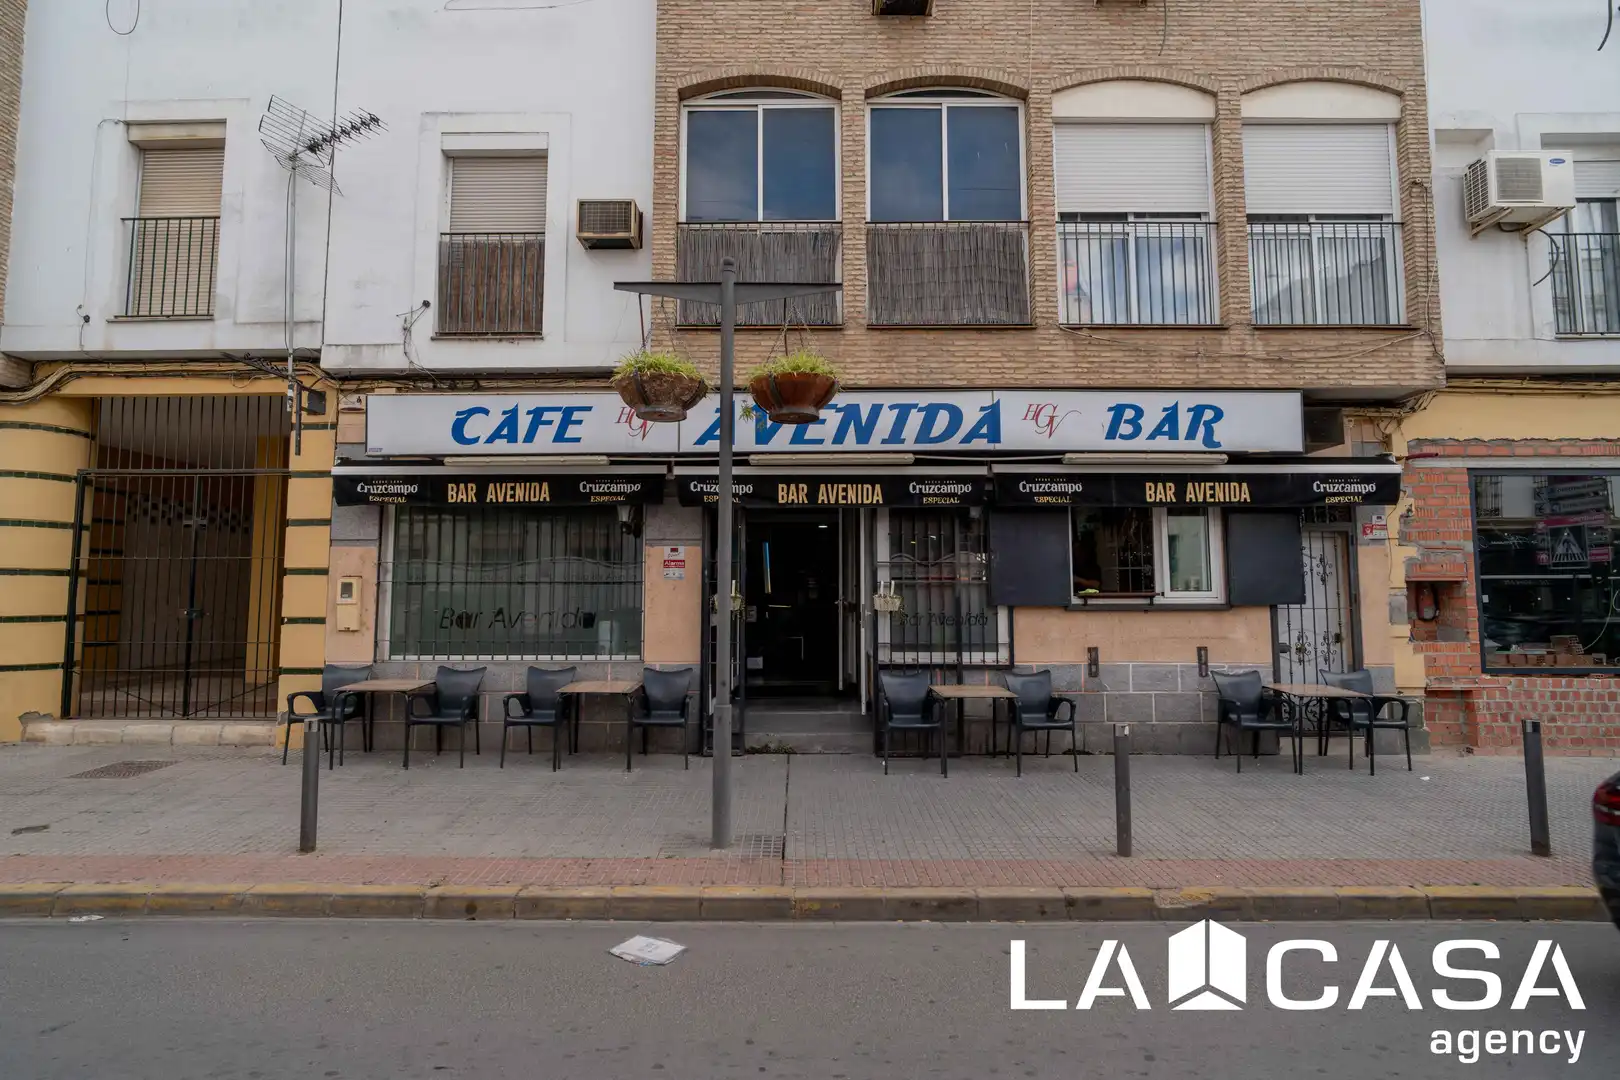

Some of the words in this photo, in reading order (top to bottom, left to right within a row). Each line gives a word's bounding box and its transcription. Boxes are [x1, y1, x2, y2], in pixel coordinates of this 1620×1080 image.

[451, 402, 593, 446] CAFE
[1104, 400, 1224, 448] BAR
[356, 482, 418, 496] Cruzcampo
[447, 482, 477, 503] BAR
[486, 481, 550, 503] AVENIDA
[579, 480, 642, 494] Cruzcampo
[689, 481, 754, 496] Cruzcmpo
[778, 483, 809, 504] BAR
[817, 483, 884, 504] AVENIDA
[908, 481, 972, 495] Cruzcampo
[1018, 480, 1083, 494] Cruzcampo
[1145, 482, 1177, 502] BAR
[1185, 482, 1251, 502] AVENIDA
[1312, 480, 1377, 494] Cruzcampo
[590, 495, 626, 503] ESPECIAL
[923, 496, 960, 504] ESPECIAL
[1325, 495, 1363, 504] ESPECIAL
